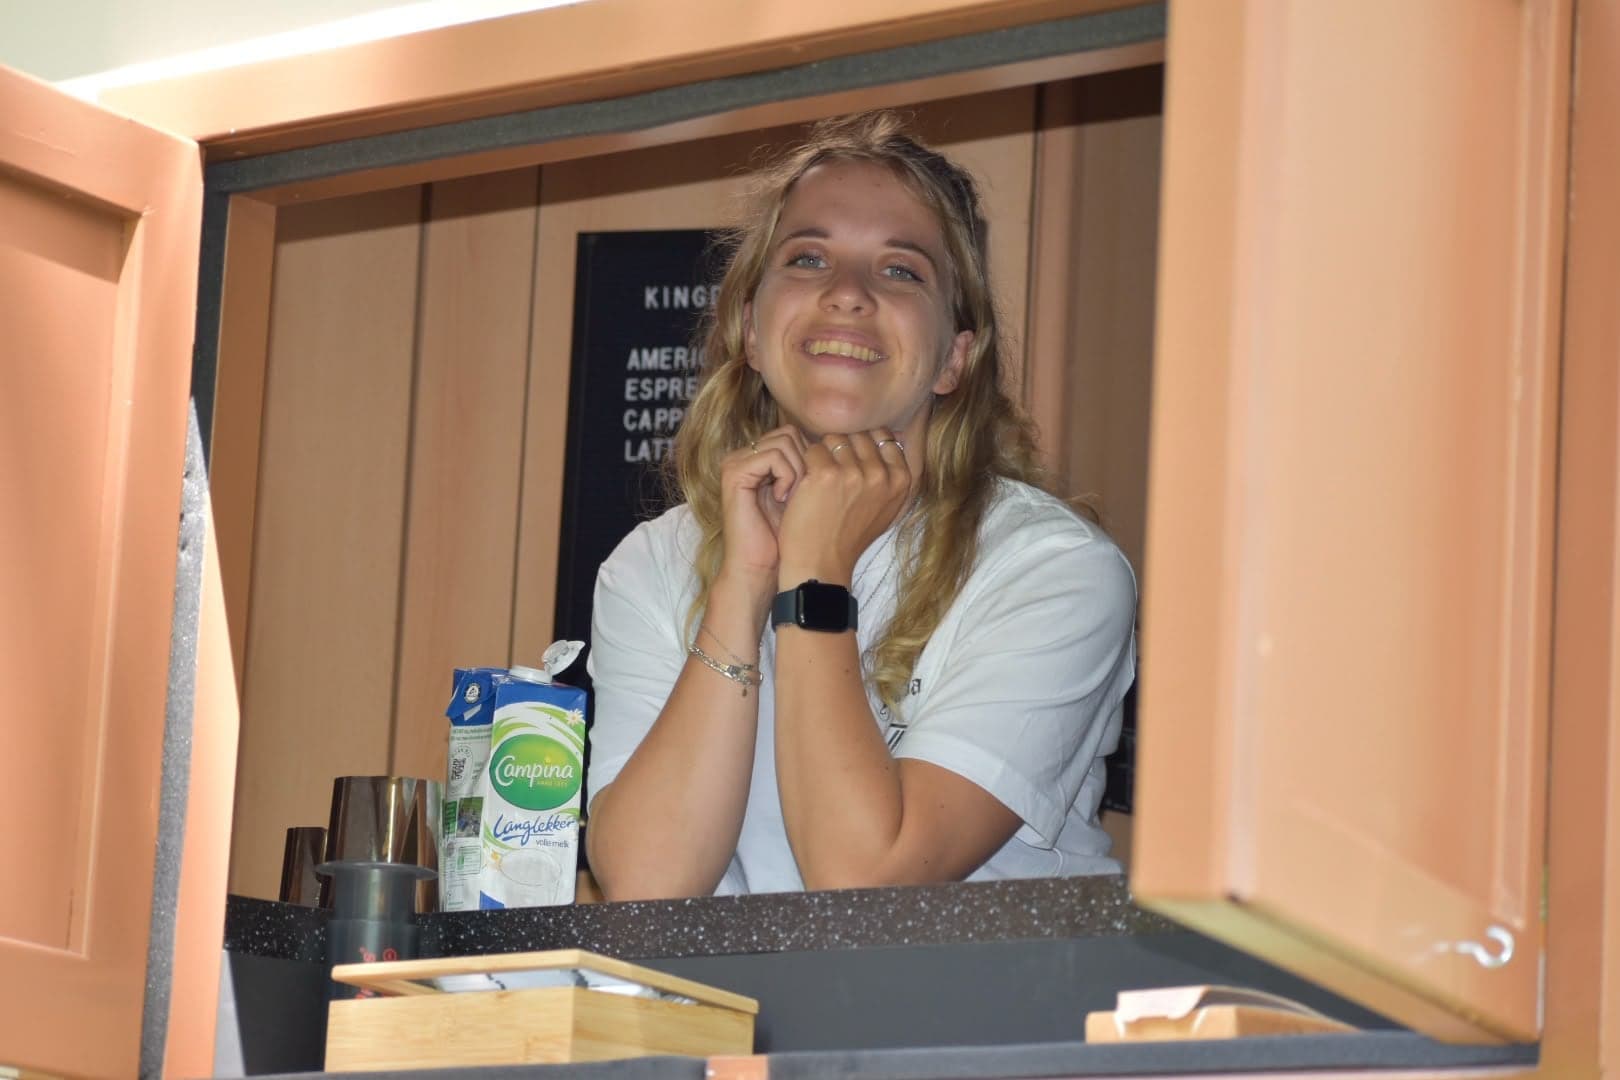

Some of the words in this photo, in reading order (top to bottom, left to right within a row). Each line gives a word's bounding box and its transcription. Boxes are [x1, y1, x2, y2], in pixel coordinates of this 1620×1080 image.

[624, 377, 697, 401] ESPRE
[623, 408, 688, 431] CAPP
[495, 755, 574, 788] Campina
